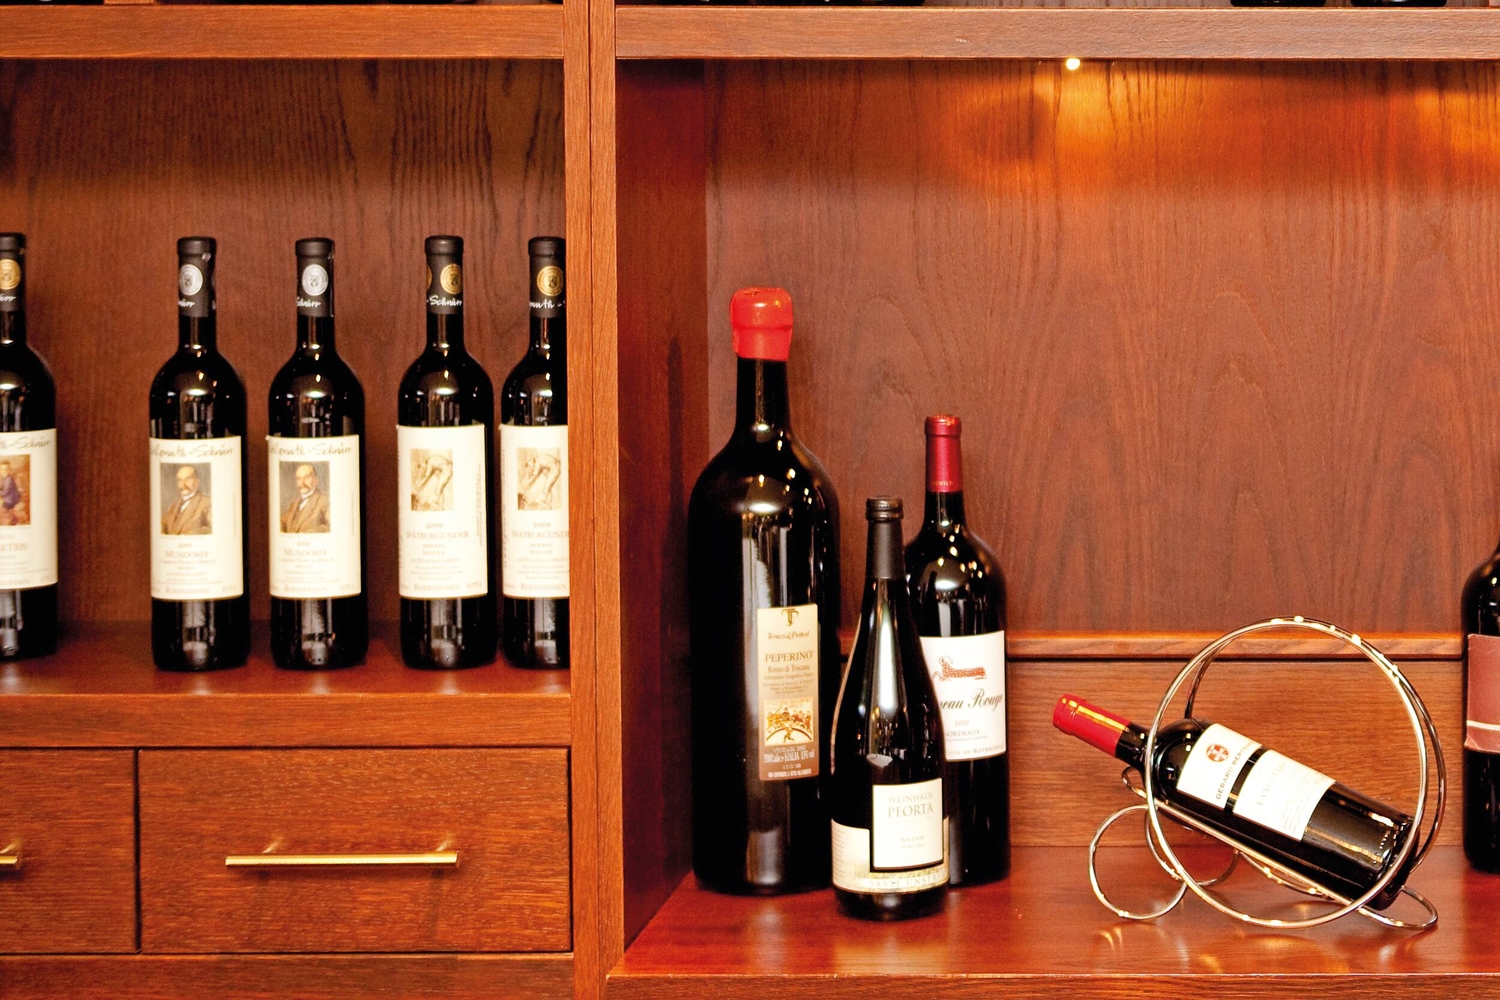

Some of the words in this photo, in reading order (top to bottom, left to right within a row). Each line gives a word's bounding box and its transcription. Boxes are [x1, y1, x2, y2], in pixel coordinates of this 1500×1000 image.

[405, 530, 470, 539] SPÄTBURGUNDER
[511, 530, 569, 539] SPÄTBURGUND
[765, 650, 814, 663] PEPERINO
[768, 665, 784, 673] Rosso
[1215, 766, 1234, 800] GÉRARD
[888, 792, 934, 803] WEINHAUS
[888, 802, 934, 818] PFORTA
